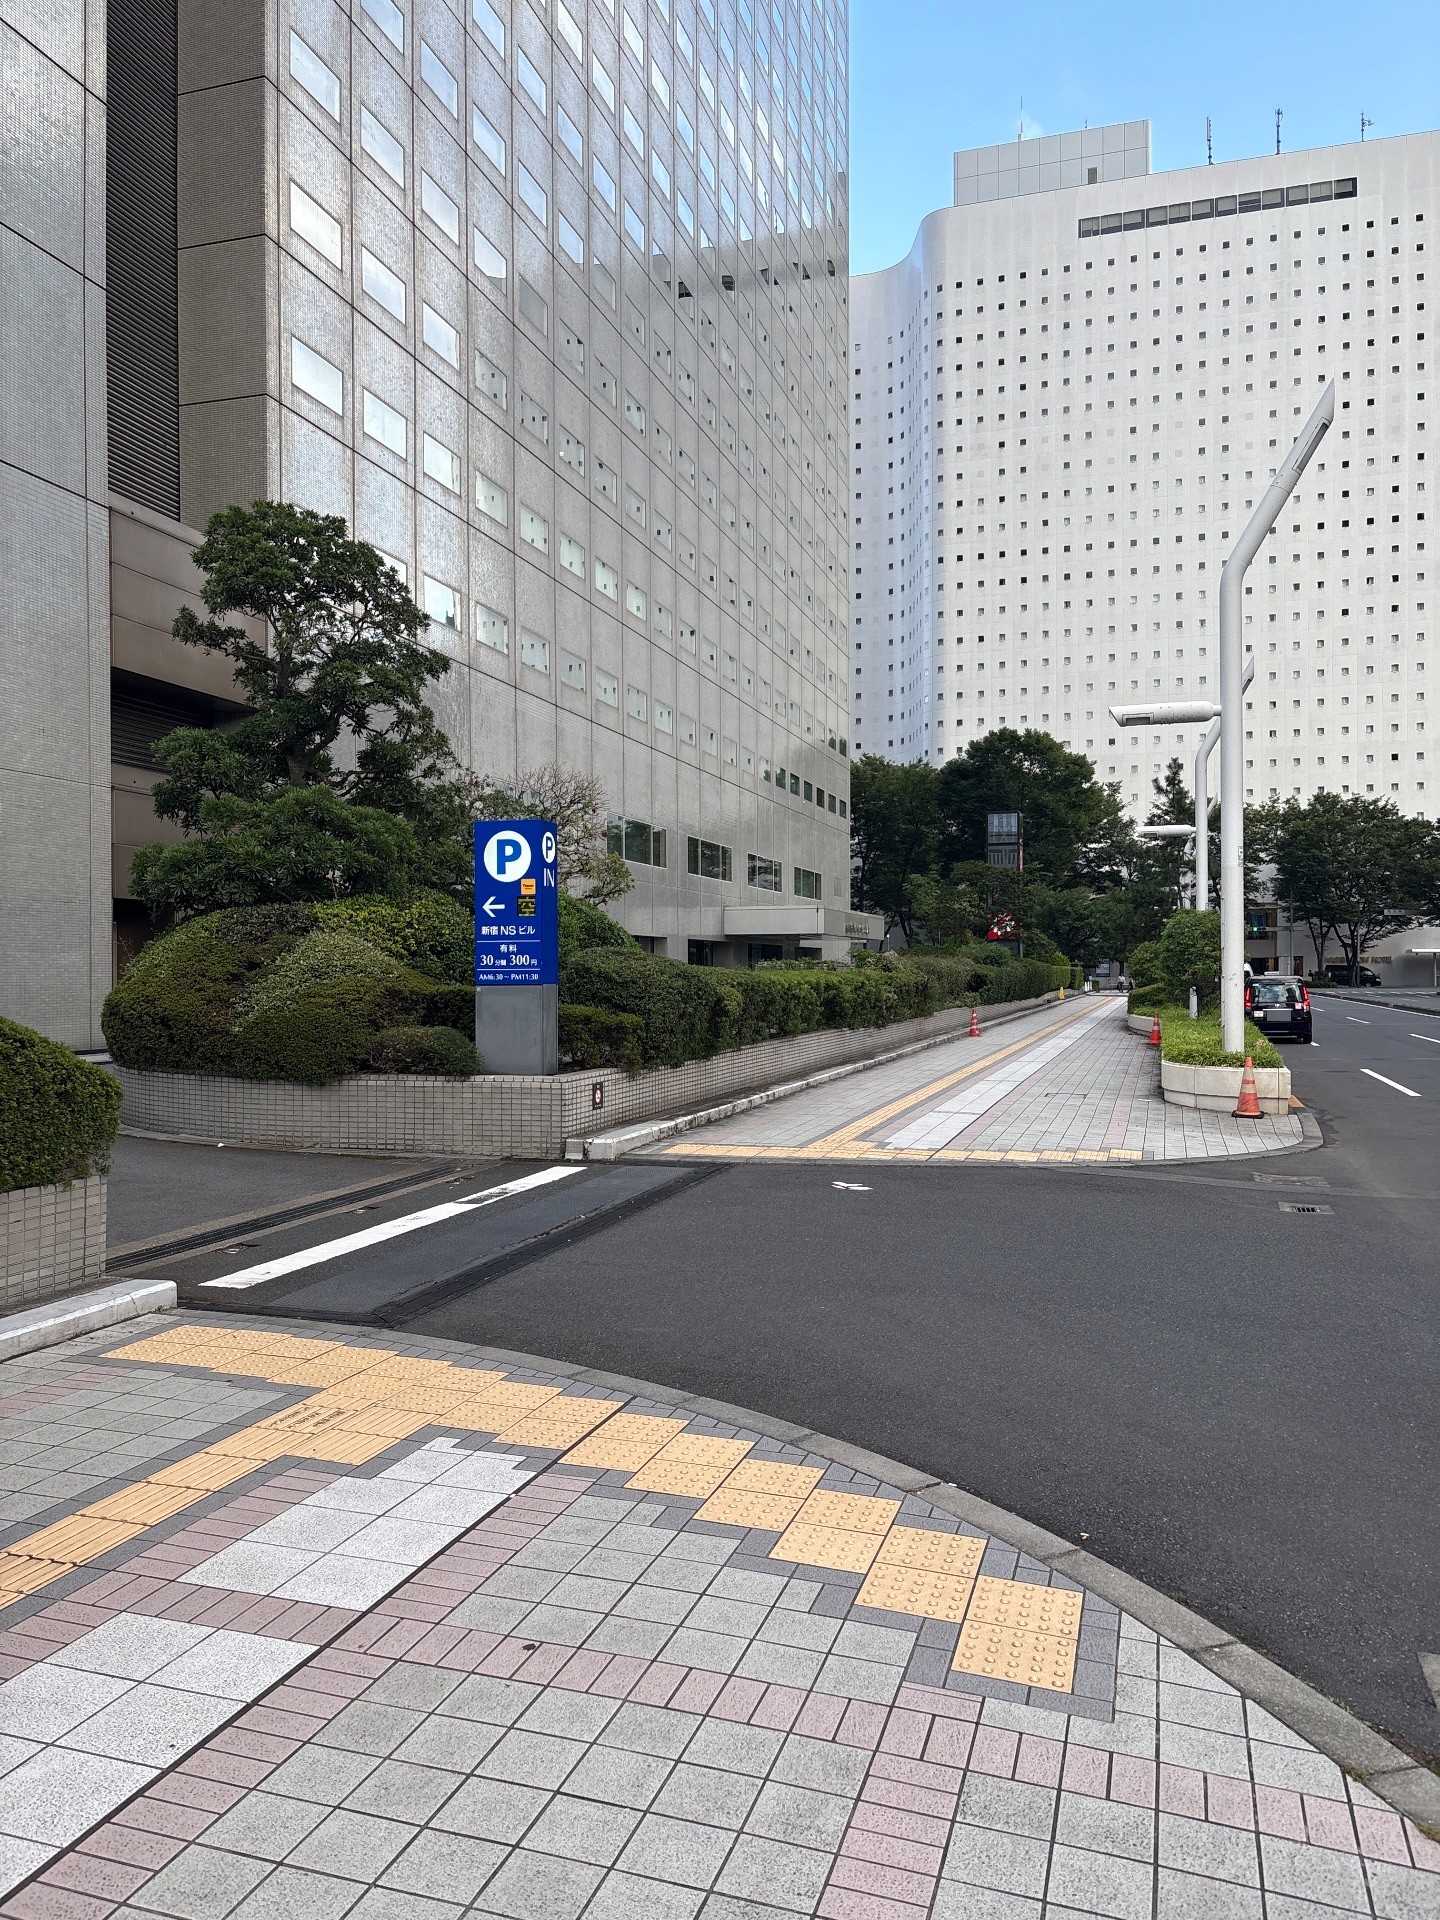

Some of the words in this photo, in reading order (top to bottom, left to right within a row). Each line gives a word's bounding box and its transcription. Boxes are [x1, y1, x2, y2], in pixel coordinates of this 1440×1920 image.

[497, 838, 522, 875] P
[545, 835, 554, 859] P
[543, 867, 555, 888] IN
[517, 896, 536, 917] 空
[499, 943, 517, 954] 有料
